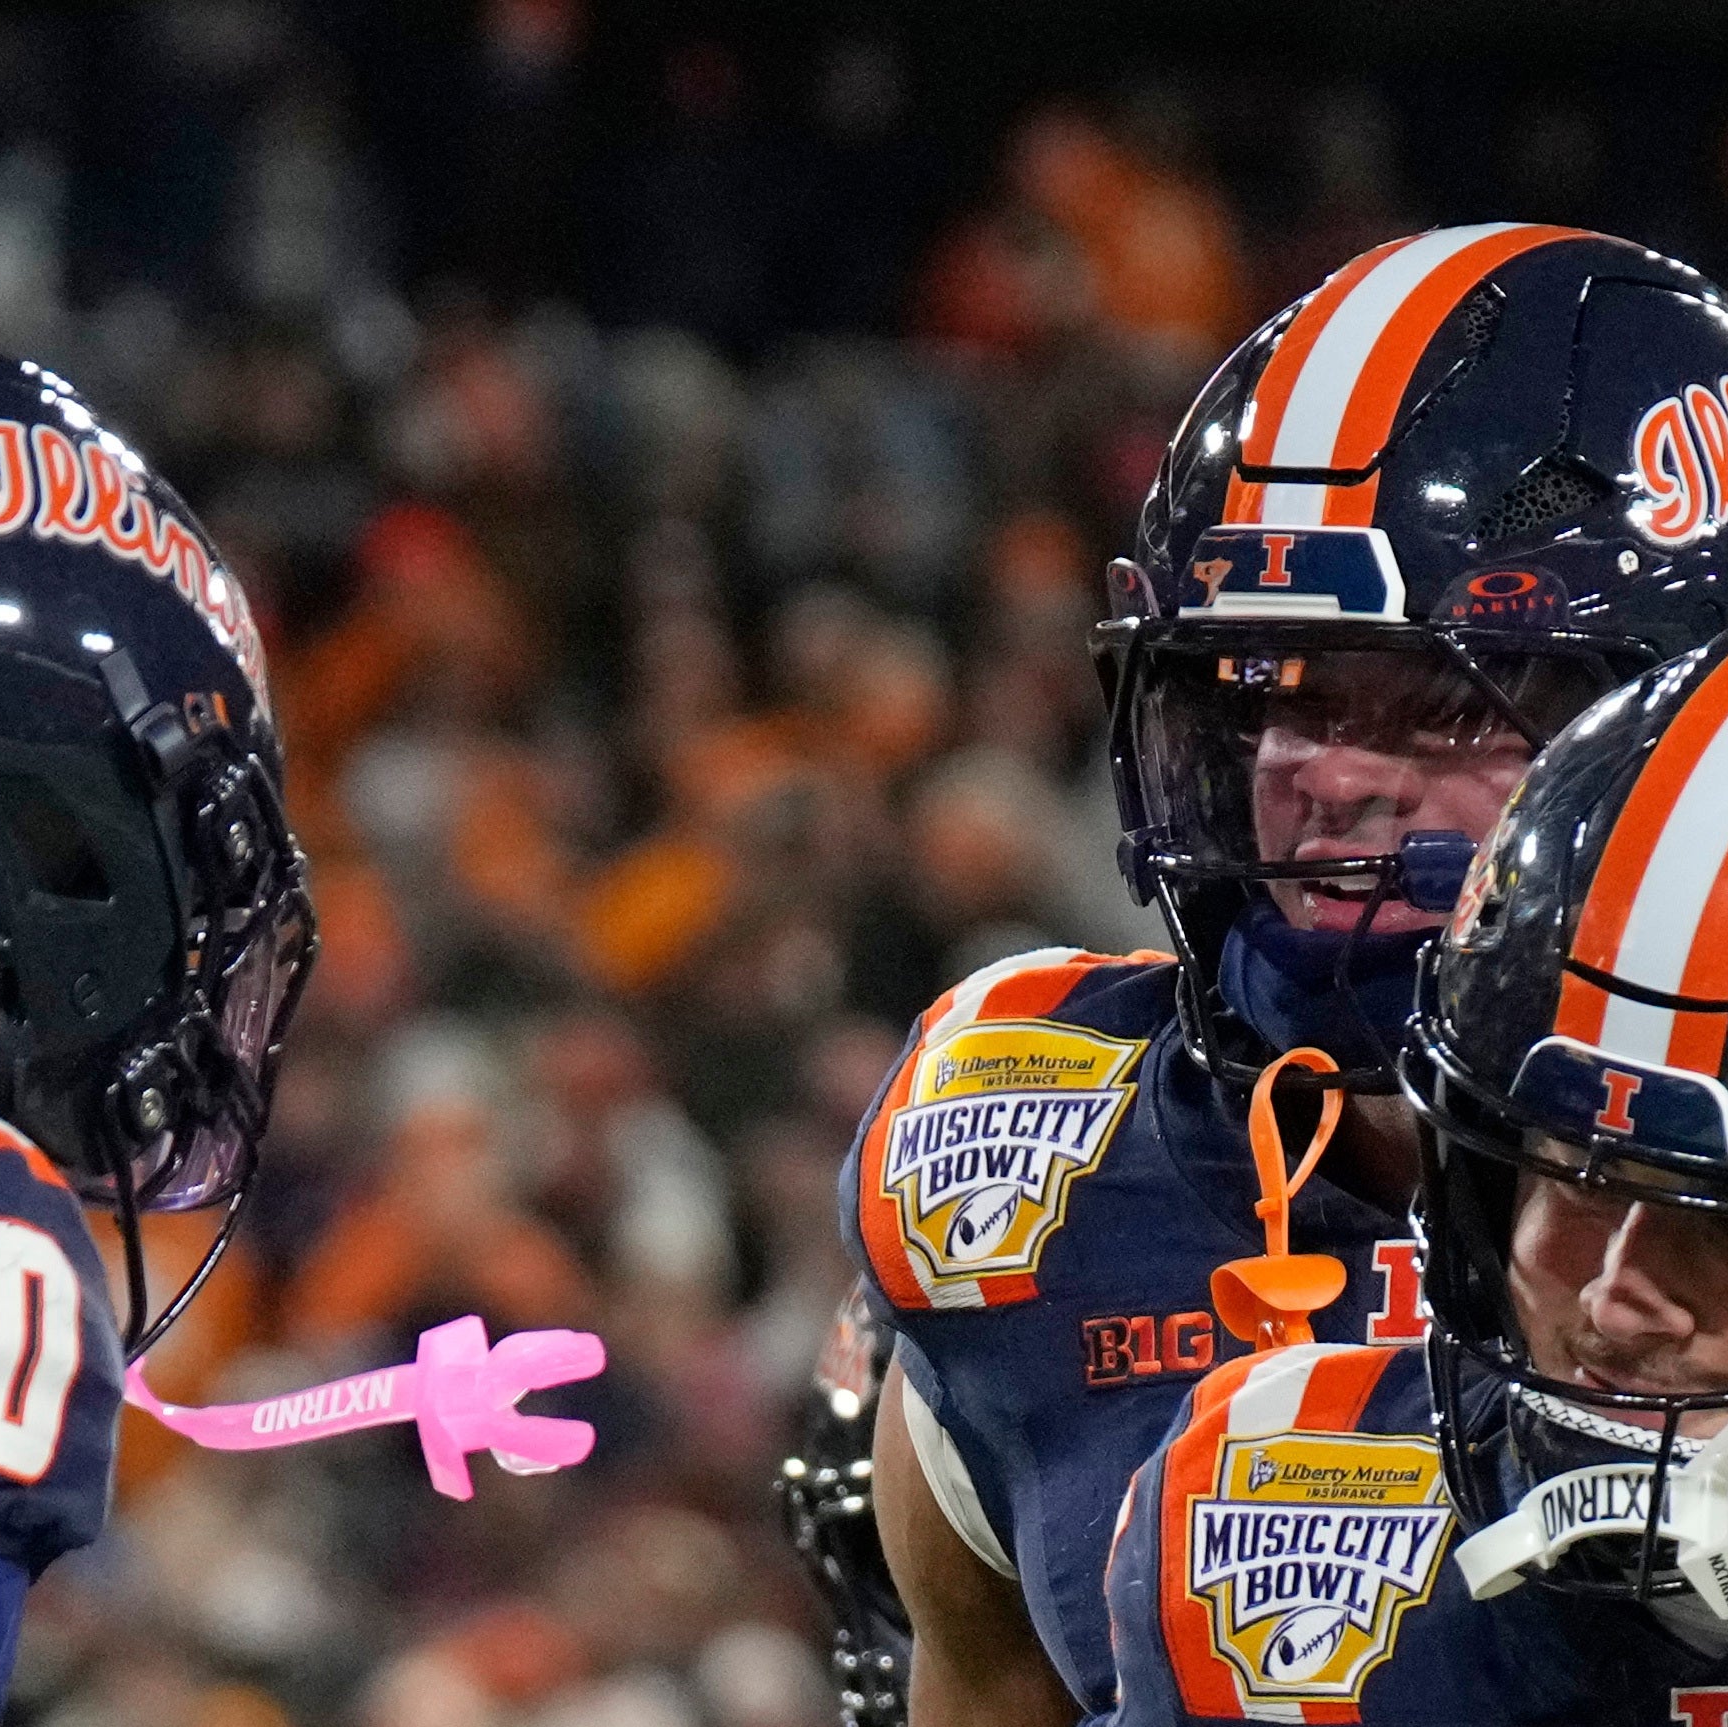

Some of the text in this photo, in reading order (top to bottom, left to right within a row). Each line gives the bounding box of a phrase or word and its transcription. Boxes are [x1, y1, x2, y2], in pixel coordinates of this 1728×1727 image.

[960, 1054, 1096, 1075] Liberty Mutual
[982, 1074, 1059, 1088] INSURANCE
[893, 1098, 1113, 1173] MUSIC CITY
[927, 1145, 1040, 1198] BOWL
[251, 1372, 394, 1434] NXTRND
[1281, 1464, 1422, 1486] Liberty Mutual
[1305, 1487, 1387, 1500] INSURANCE
[1200, 1512, 1440, 1577] MUSIC CITY
[1244, 1561, 1369, 1613] BOWL
